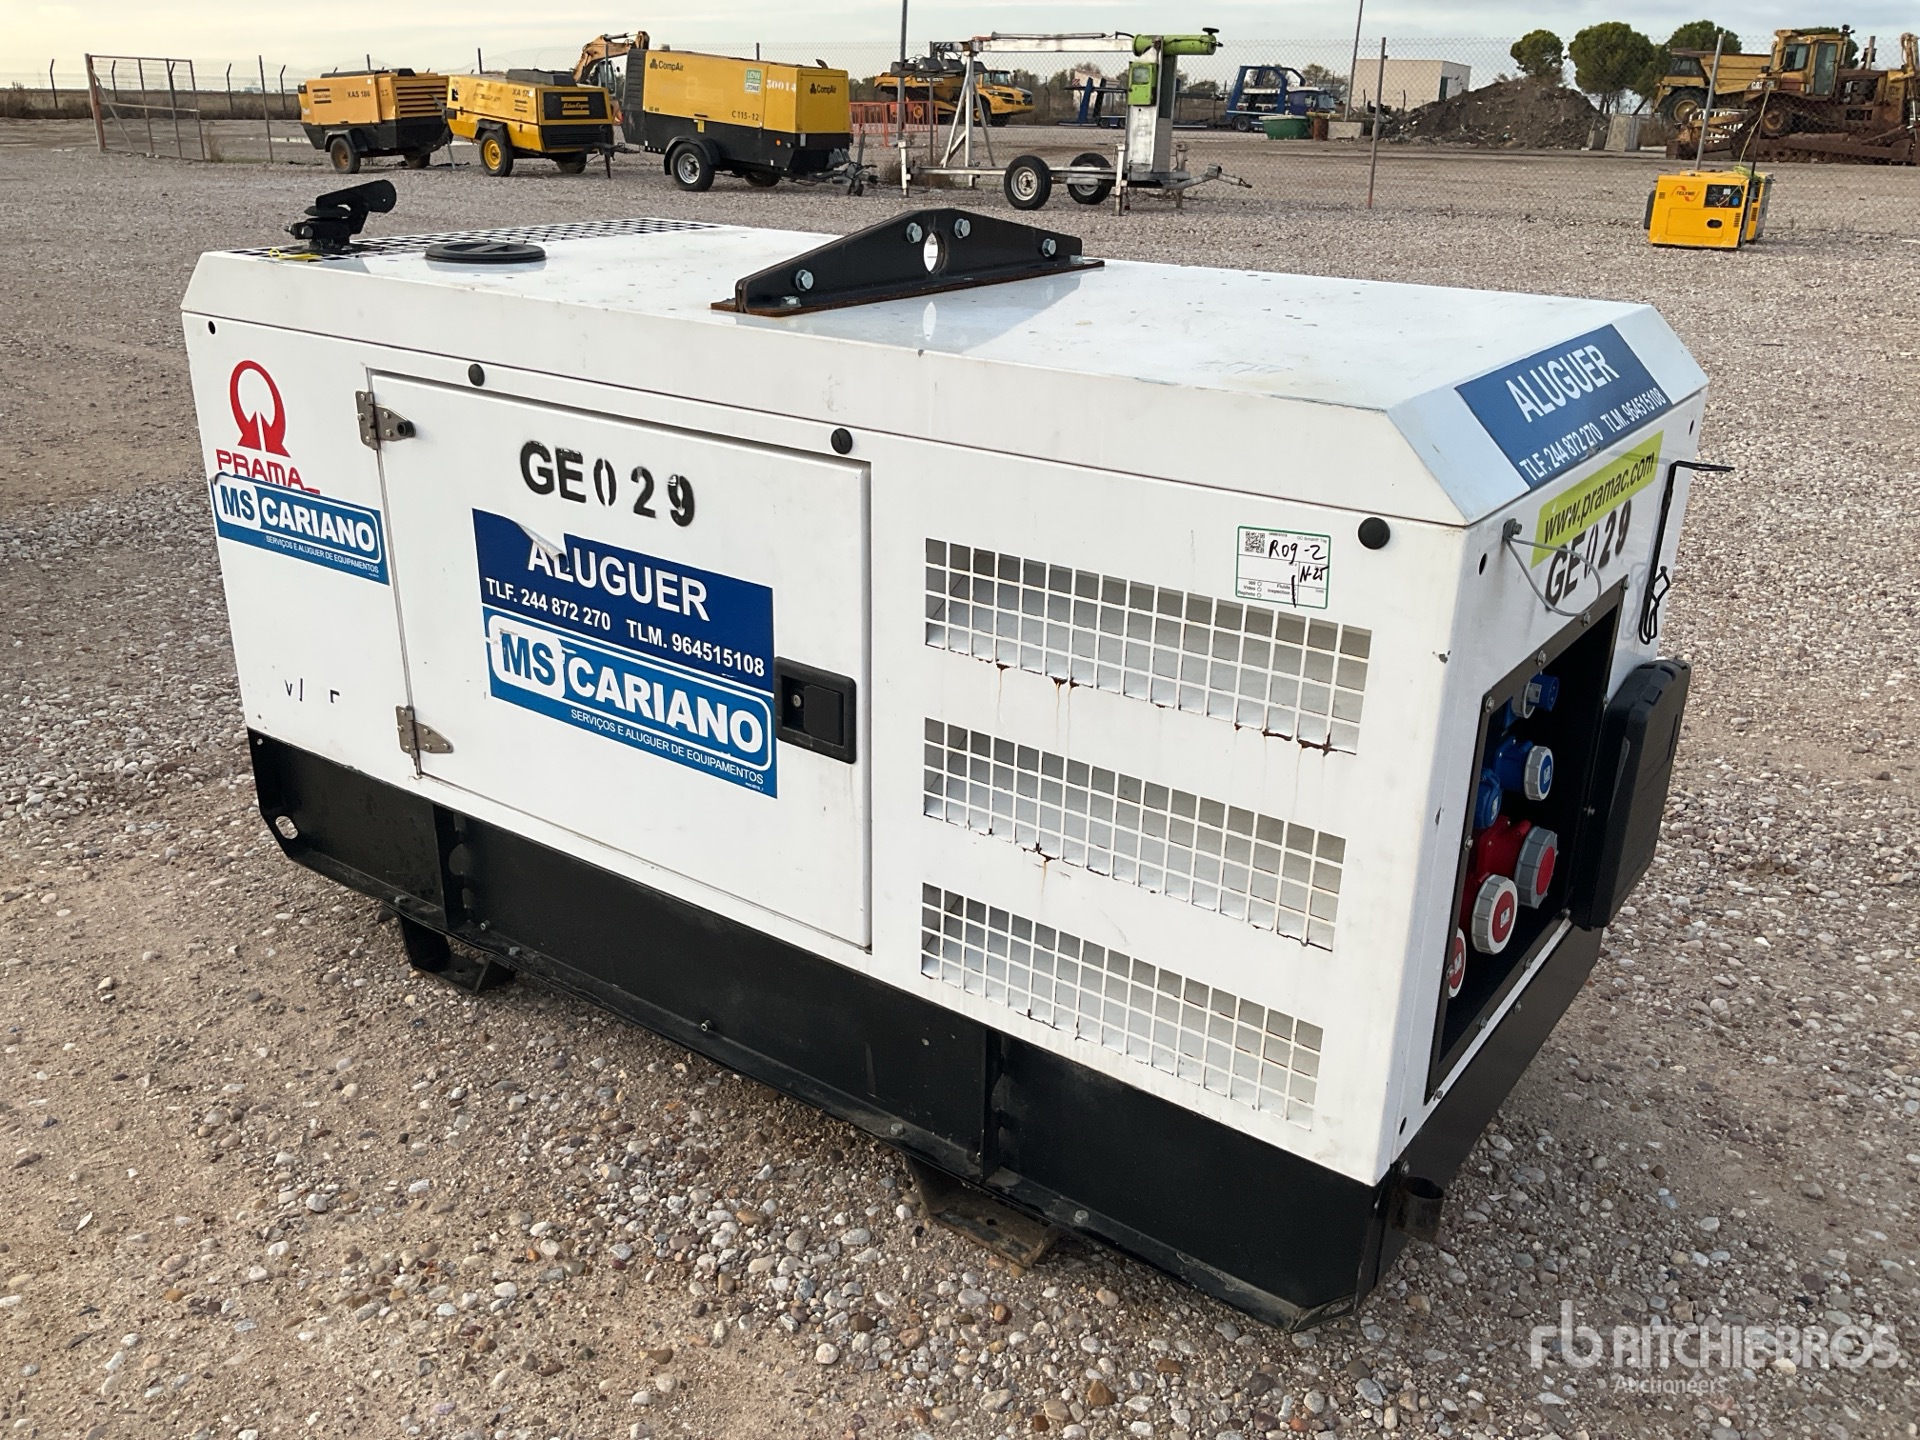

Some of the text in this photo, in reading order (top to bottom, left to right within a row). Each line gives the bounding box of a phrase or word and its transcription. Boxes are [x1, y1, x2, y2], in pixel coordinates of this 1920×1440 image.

[347, 90, 359, 98] XAS
[658, 61, 684, 71] CompAir
[747, 71, 760, 80] LOW
[816, 84, 837, 95] CompAir
[1505, 344, 1620, 423] ALUGUER
[1519, 387, 1666, 481] TLF. 244 872 270 TLM. 964515108
[216, 449, 320, 496] PRAMA
[1543, 451, 1655, 545] www.pramac.com
[220, 485, 375, 553] MS CARIANO
[265, 535, 293, 549] SERVIÇOS
[298, 544, 325, 558] ALUGUER
[325, 551, 333, 561] DE
[334, 554, 379, 574] EQUIPAMENTOS
[527, 541, 710, 622] ALUGUER
[485, 577, 765, 677] TLF. 244 872 270 TLM. 964515108
[500, 632, 763, 754] MS CARIANO
[571, 709, 764, 785] SERVIÇOS E ALUGUER DE EQUIPAMENTOS
